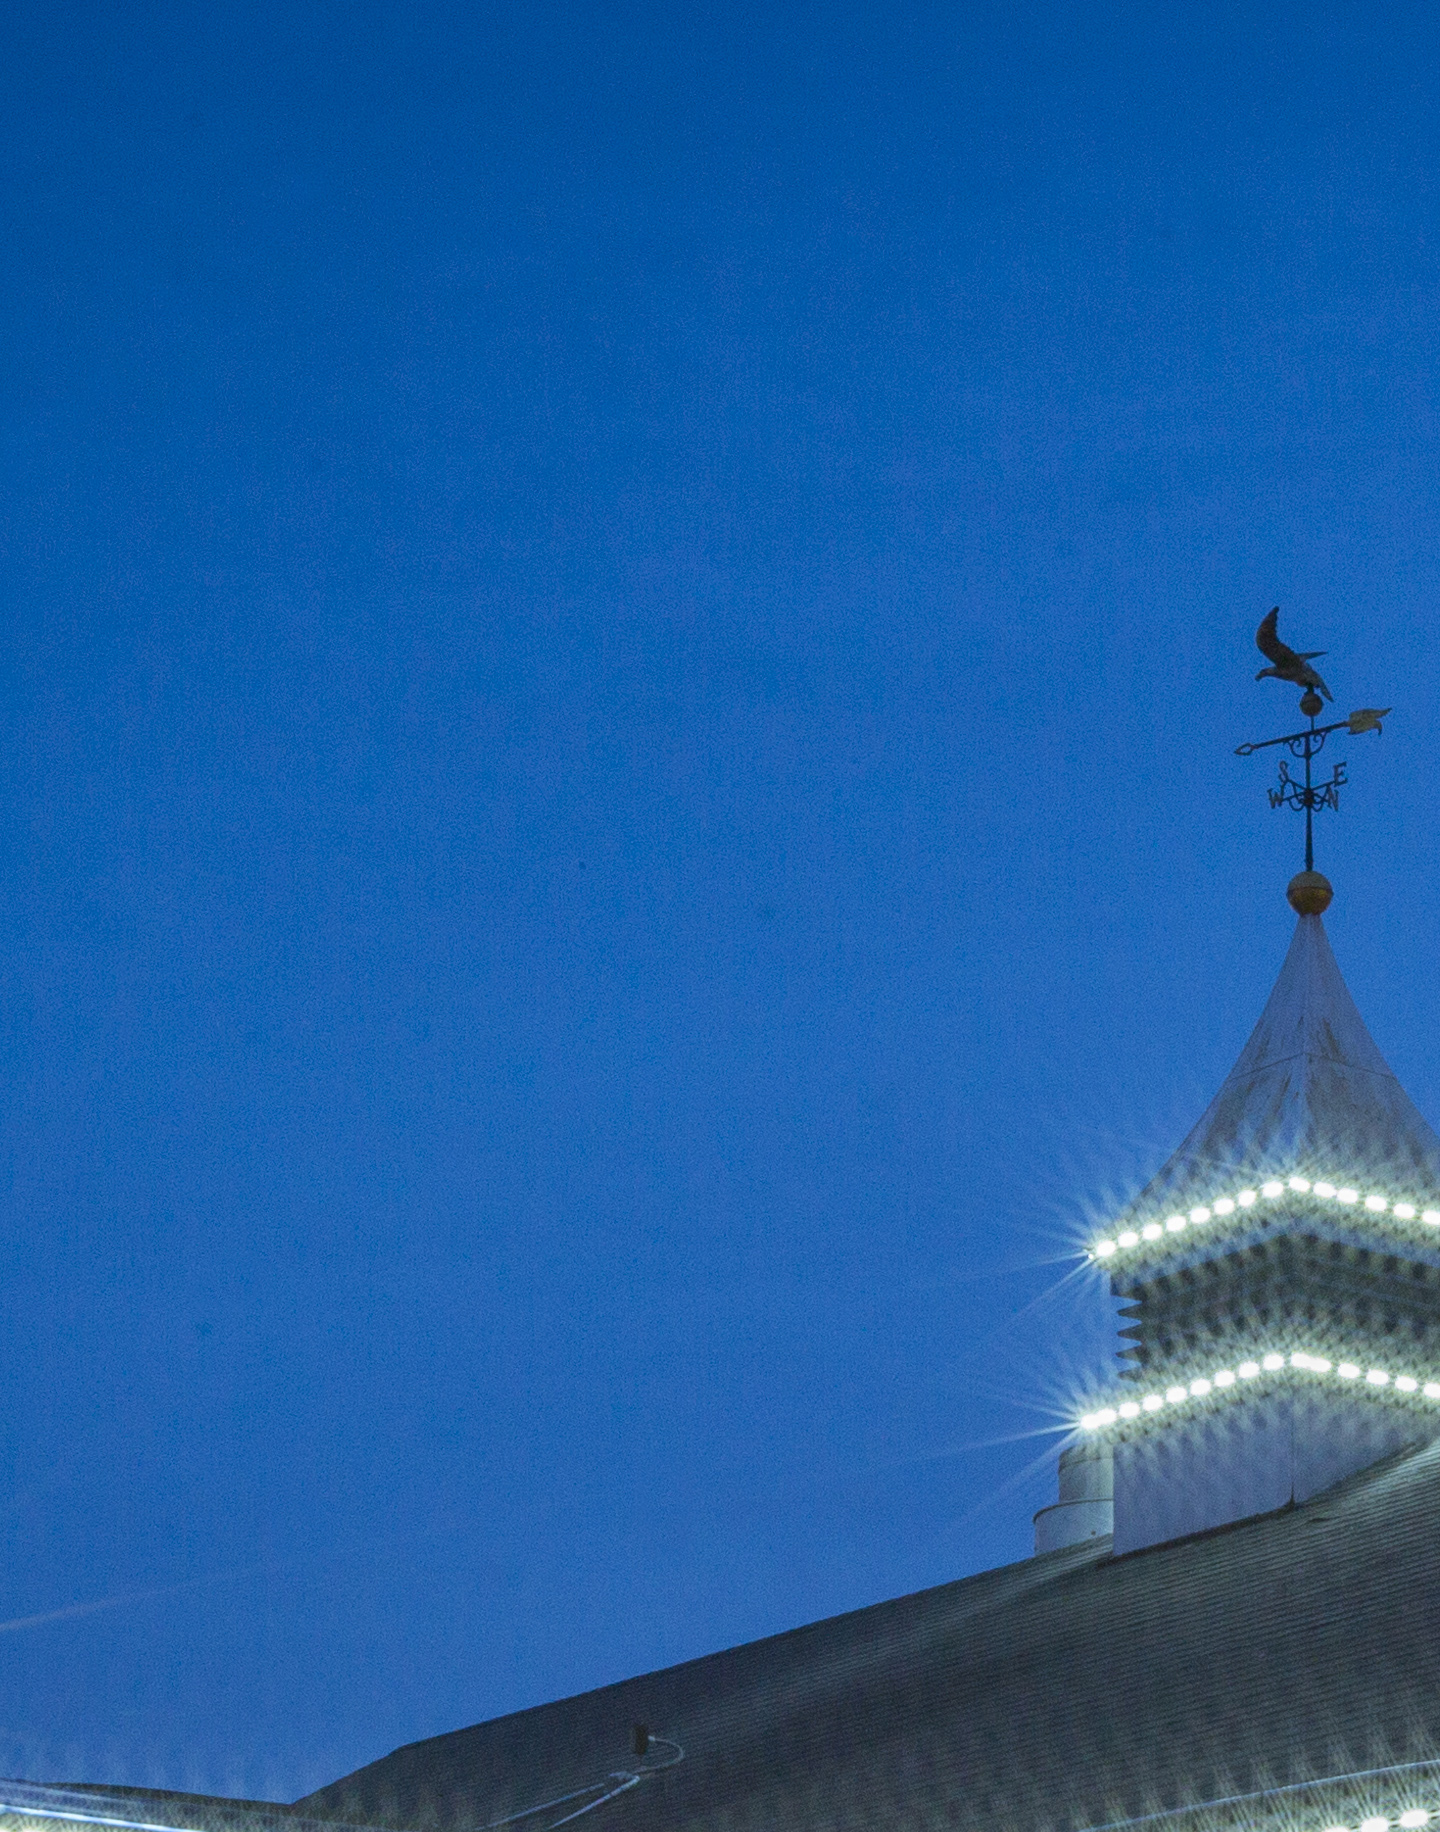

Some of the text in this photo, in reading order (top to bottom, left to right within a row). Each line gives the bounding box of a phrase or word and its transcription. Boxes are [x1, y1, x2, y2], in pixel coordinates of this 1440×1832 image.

[1278, 761, 1289, 783] S
[1333, 762, 1348, 786] E
[1266, 788, 1286, 809] W
[1328, 788, 1340, 812] N
